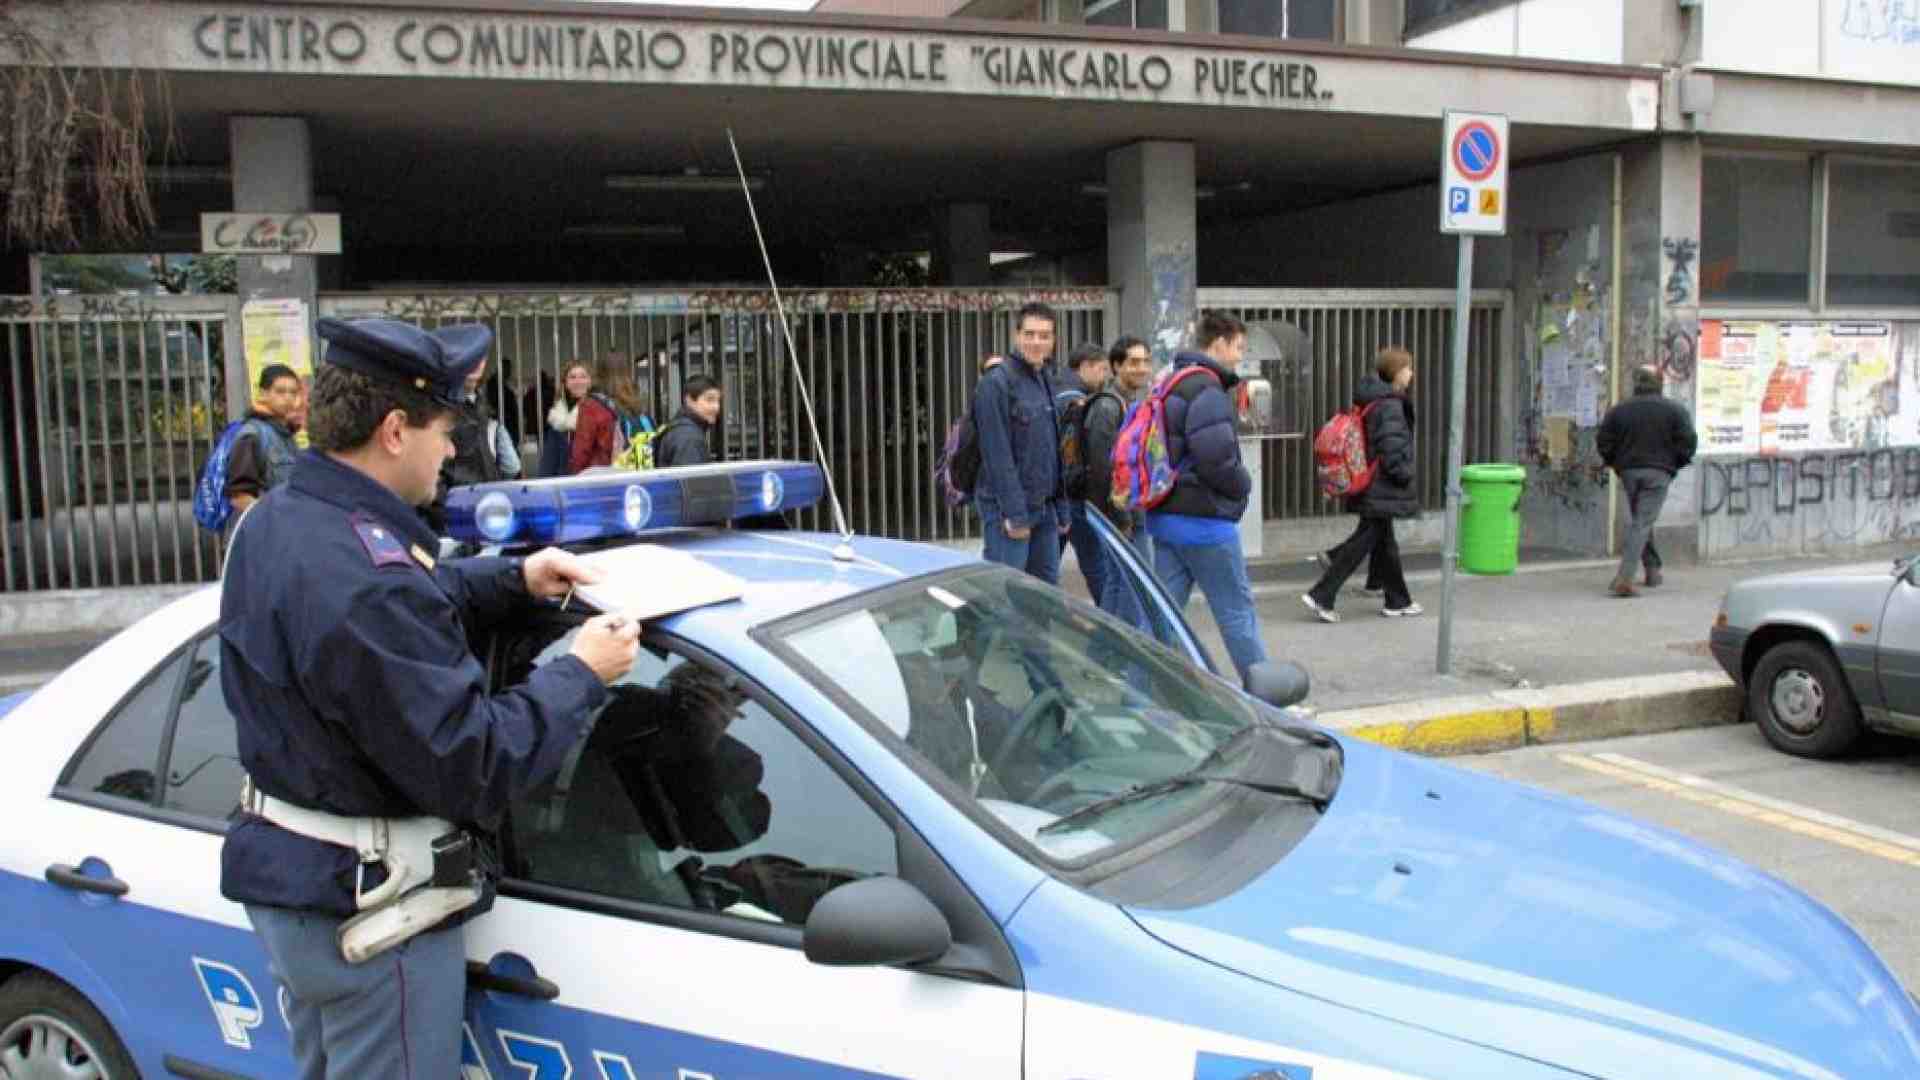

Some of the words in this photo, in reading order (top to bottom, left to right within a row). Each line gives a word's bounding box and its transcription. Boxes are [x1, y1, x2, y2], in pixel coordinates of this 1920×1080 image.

[194, 14, 366, 62] CENTRO
[394, 20, 686, 70] COMUNITARIO
[709, 33, 947, 82] PROVINCIALE
